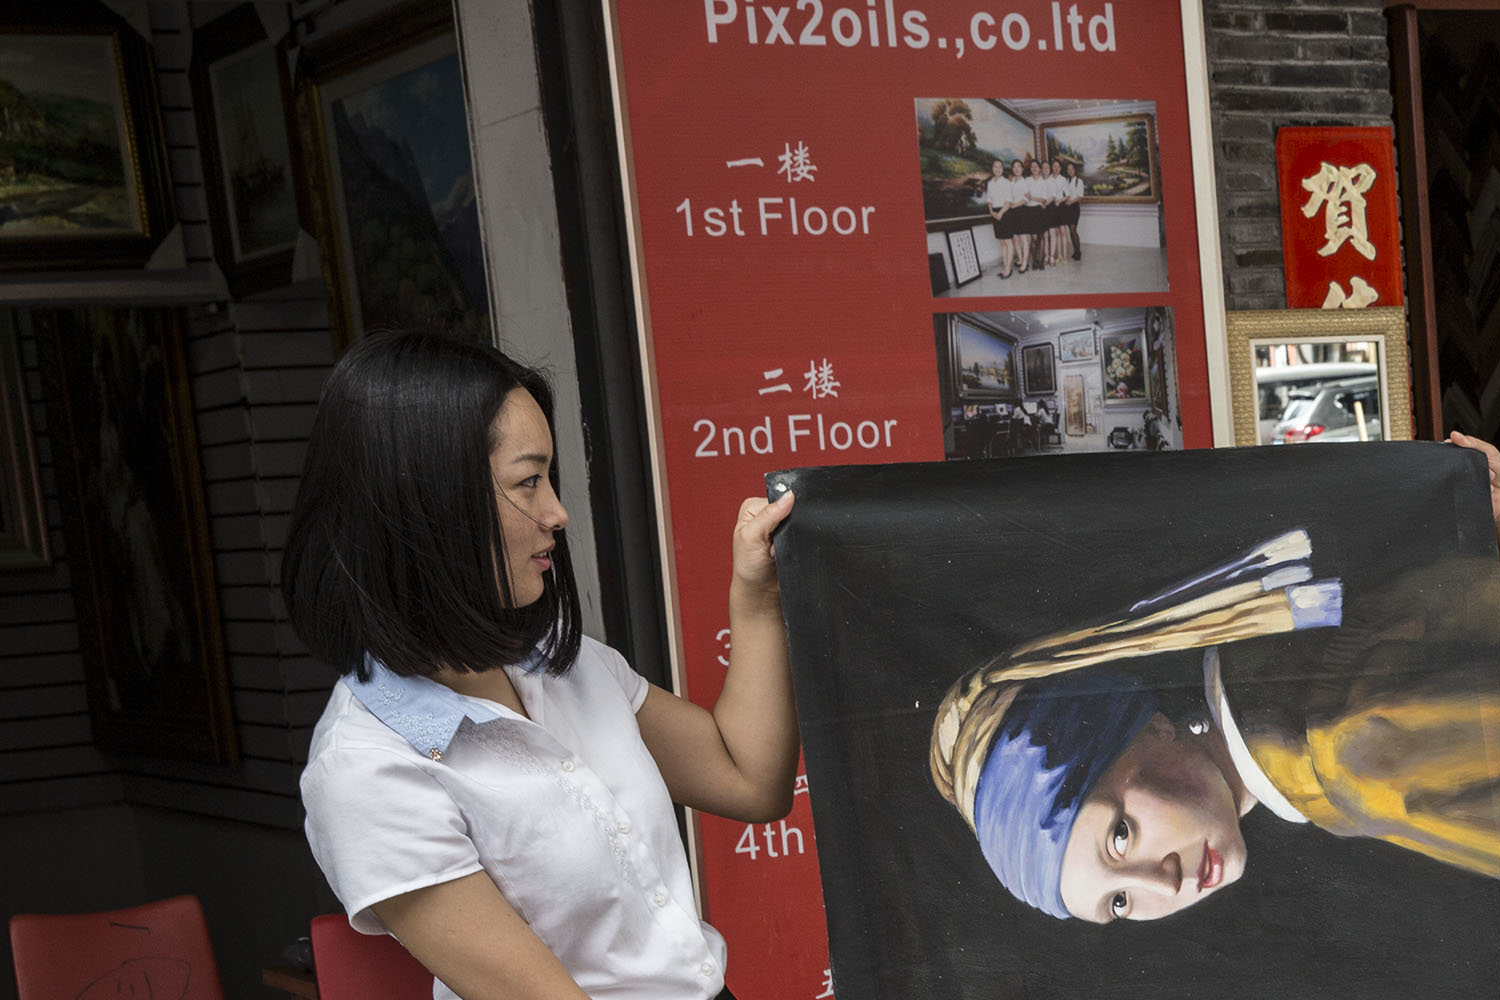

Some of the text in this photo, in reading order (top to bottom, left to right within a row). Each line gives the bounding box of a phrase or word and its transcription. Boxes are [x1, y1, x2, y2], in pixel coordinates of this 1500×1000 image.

[726, 141, 818, 183] 一楼
[676, 197, 876, 237] 1st Floor
[758, 357, 841, 400] 二楼
[693, 413, 898, 458] 2nd Floor
[735, 820, 804, 860] 4th
